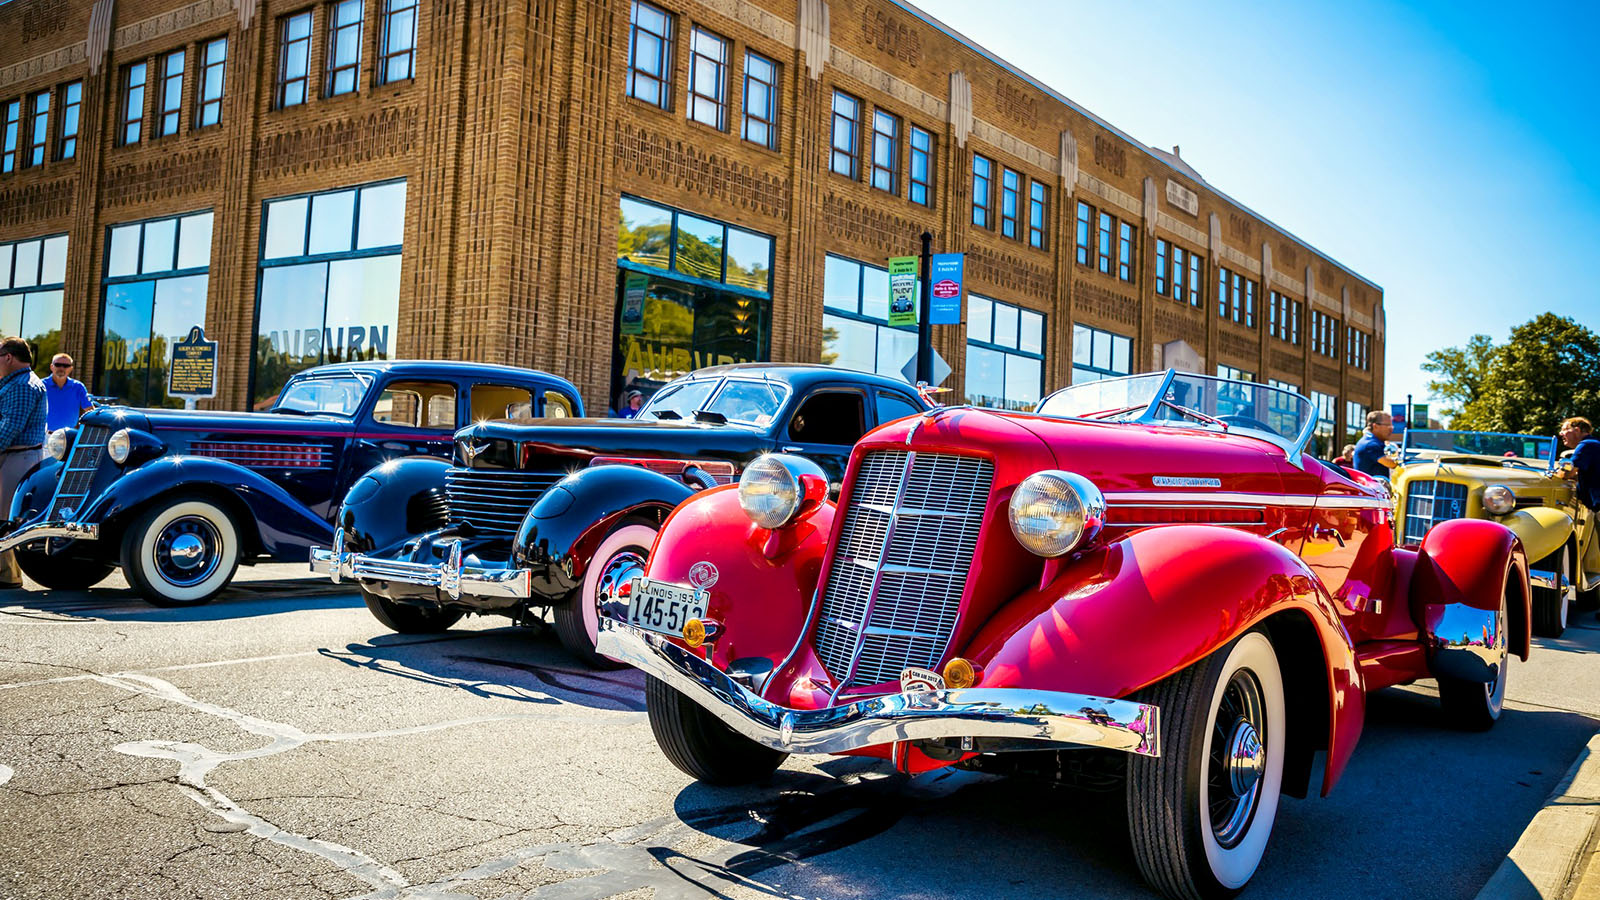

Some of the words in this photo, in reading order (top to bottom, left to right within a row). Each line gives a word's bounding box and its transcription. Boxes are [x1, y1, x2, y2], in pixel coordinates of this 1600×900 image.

[104, 336, 178, 370] DUESENBE
[263, 325, 389, 365] AUBURN
[622, 341, 757, 379] AUBU
